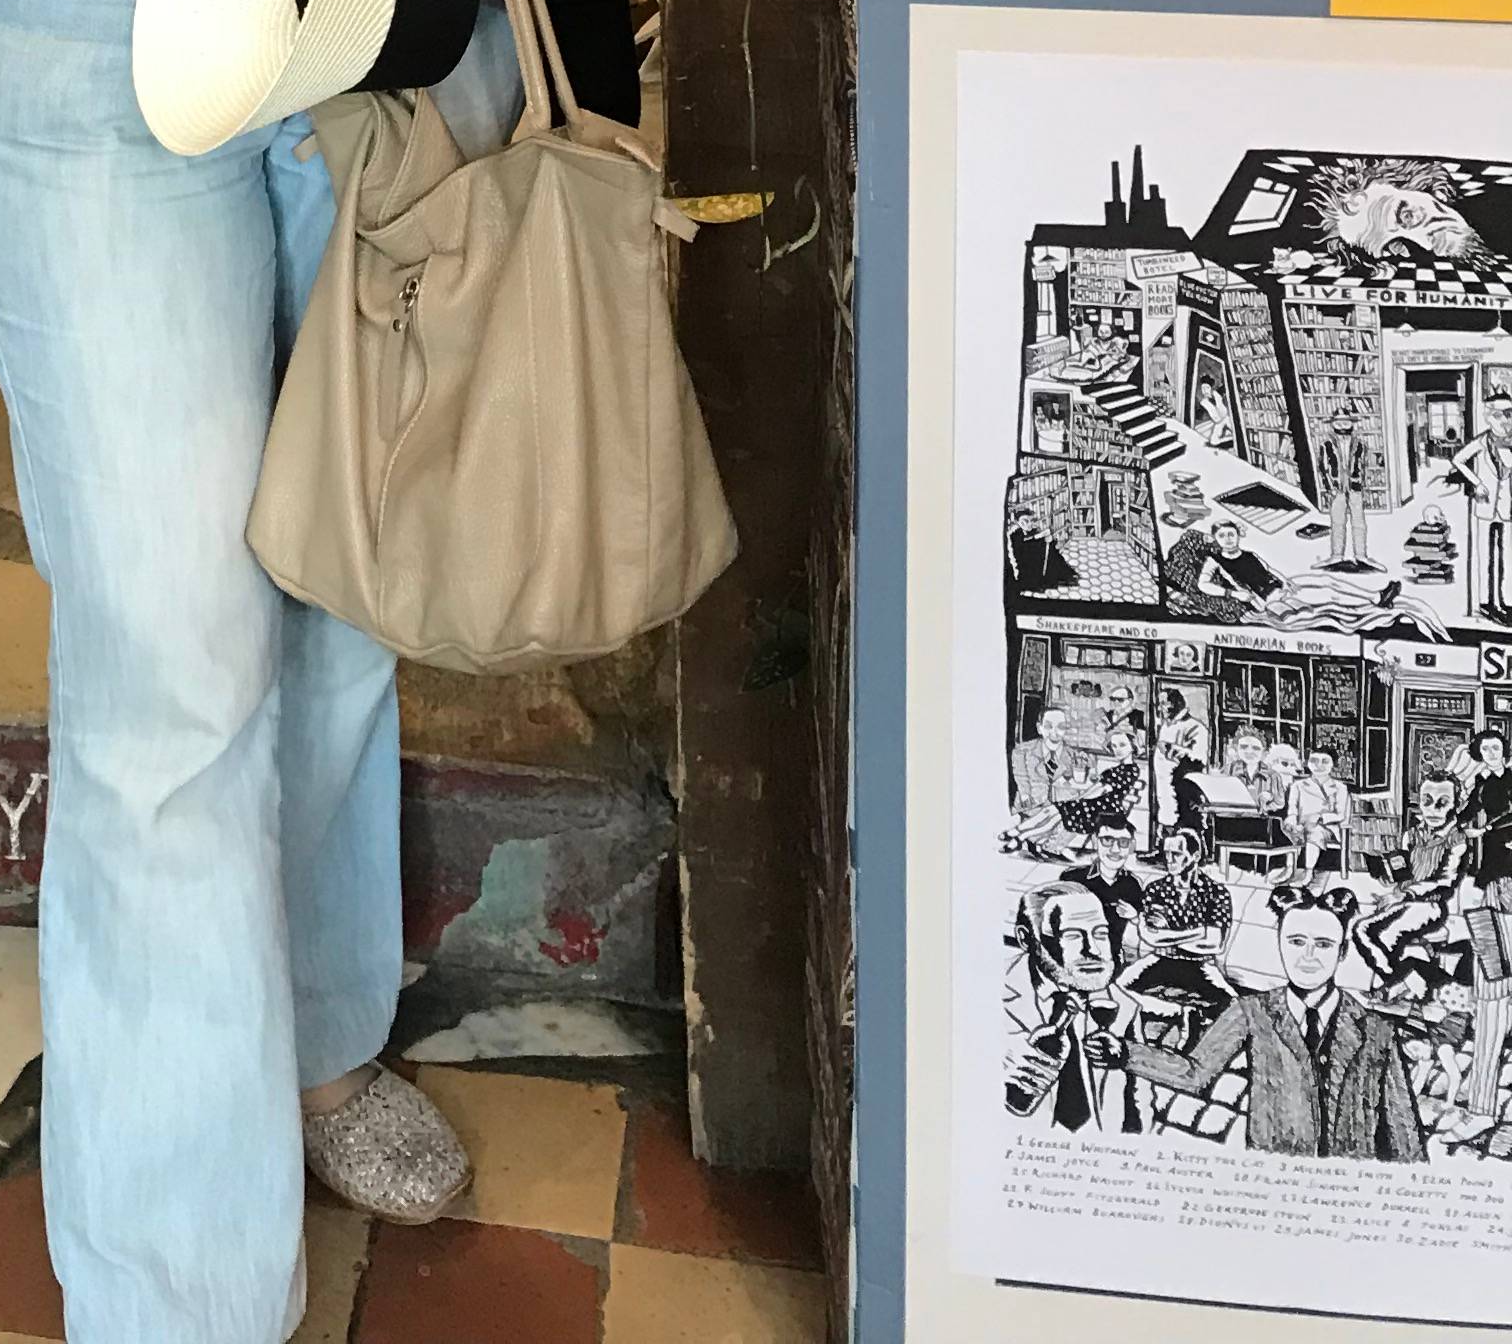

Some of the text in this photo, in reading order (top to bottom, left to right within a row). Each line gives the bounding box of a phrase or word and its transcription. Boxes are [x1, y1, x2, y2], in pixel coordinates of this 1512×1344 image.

[1292, 287, 1353, 299] LIVE
[1366, 289, 1408, 304] FOR
[1036, 616, 1159, 639] SHAKESPEARE AND CO
[1213, 632, 1287, 652] ANTIQUARIAN
